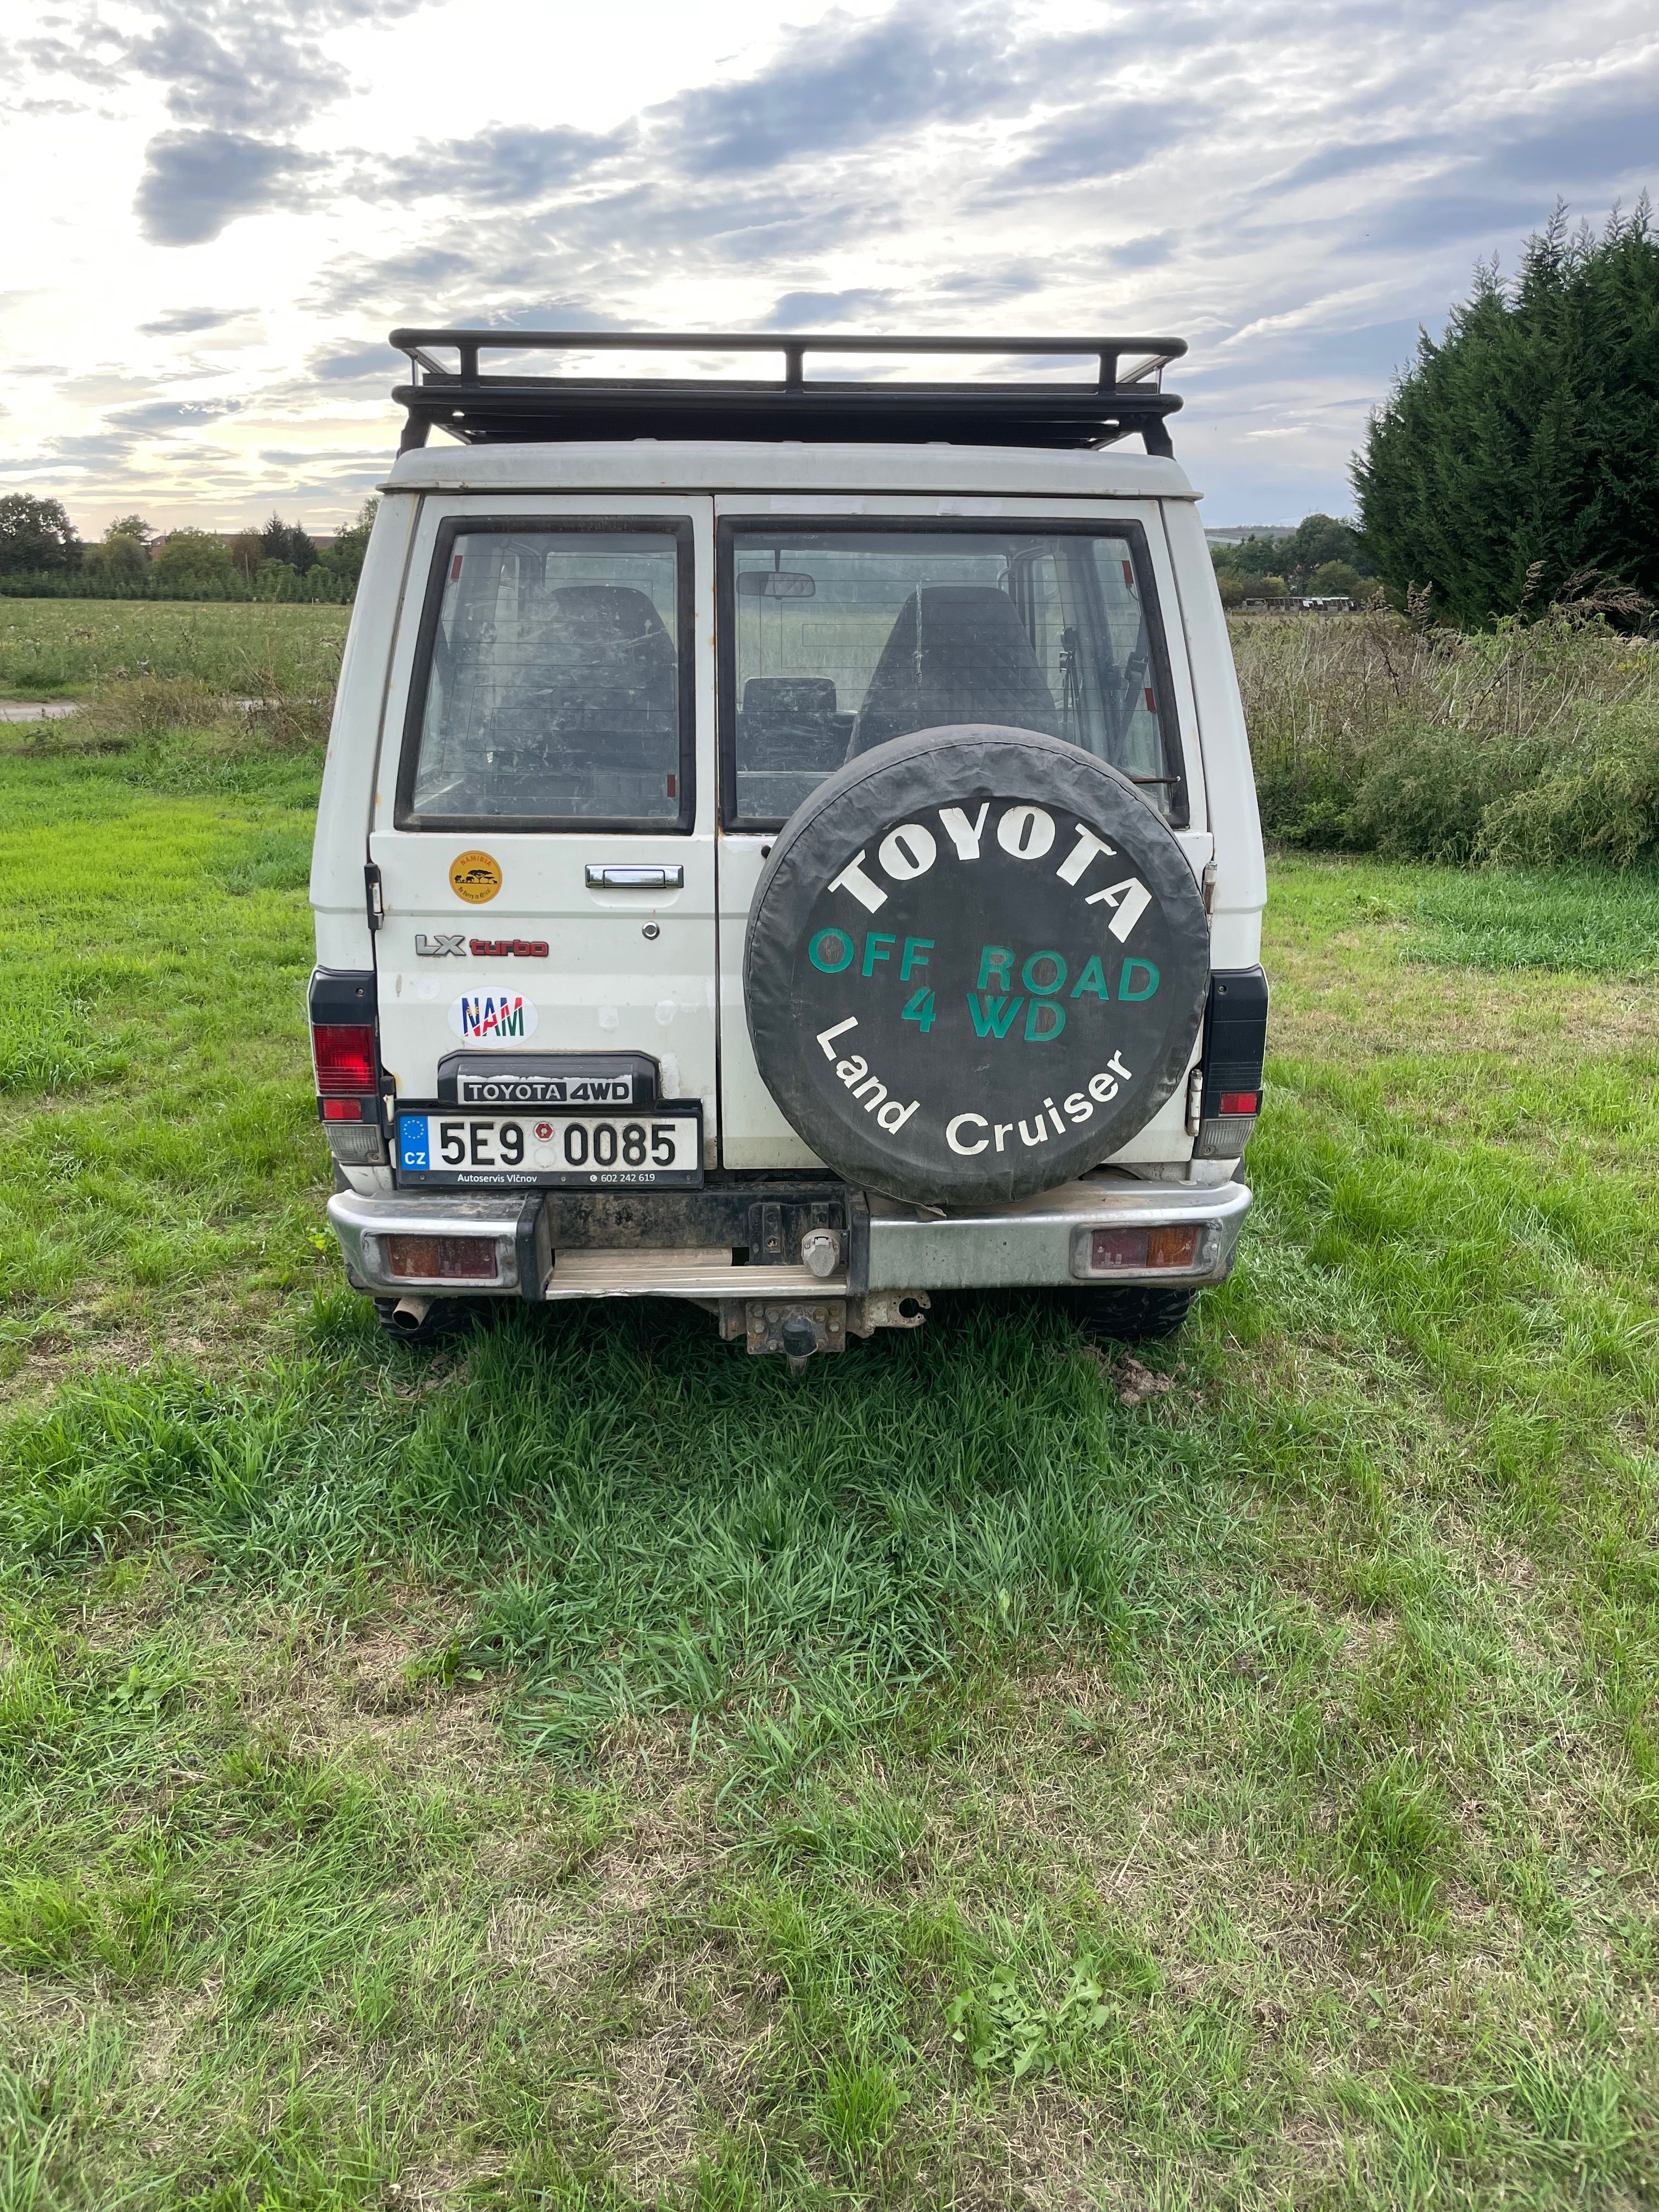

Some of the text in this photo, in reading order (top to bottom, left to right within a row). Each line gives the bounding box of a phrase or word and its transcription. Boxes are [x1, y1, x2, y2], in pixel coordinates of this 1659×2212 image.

[460, 855, 492, 866] NAMIBIA
[827, 802, 1152, 943] TOYOTA
[415, 935, 549, 956] LX turbo
[808, 928, 1160, 1002] OFF ROAD
[461, 997, 524, 1036] NAM
[901, 988, 1066, 1041] 4 WD
[469, 1082, 630, 1100] TOYOTA 4WD
[816, 1016, 1132, 1156] Land Cruiser
[404, 1152, 426, 1165] CZ
[439, 1122, 676, 1166] 5E9 0085
[457, 1173, 538, 1183] Autoservis Vlčnov
[601, 1173, 656, 1183] 602 242 619
